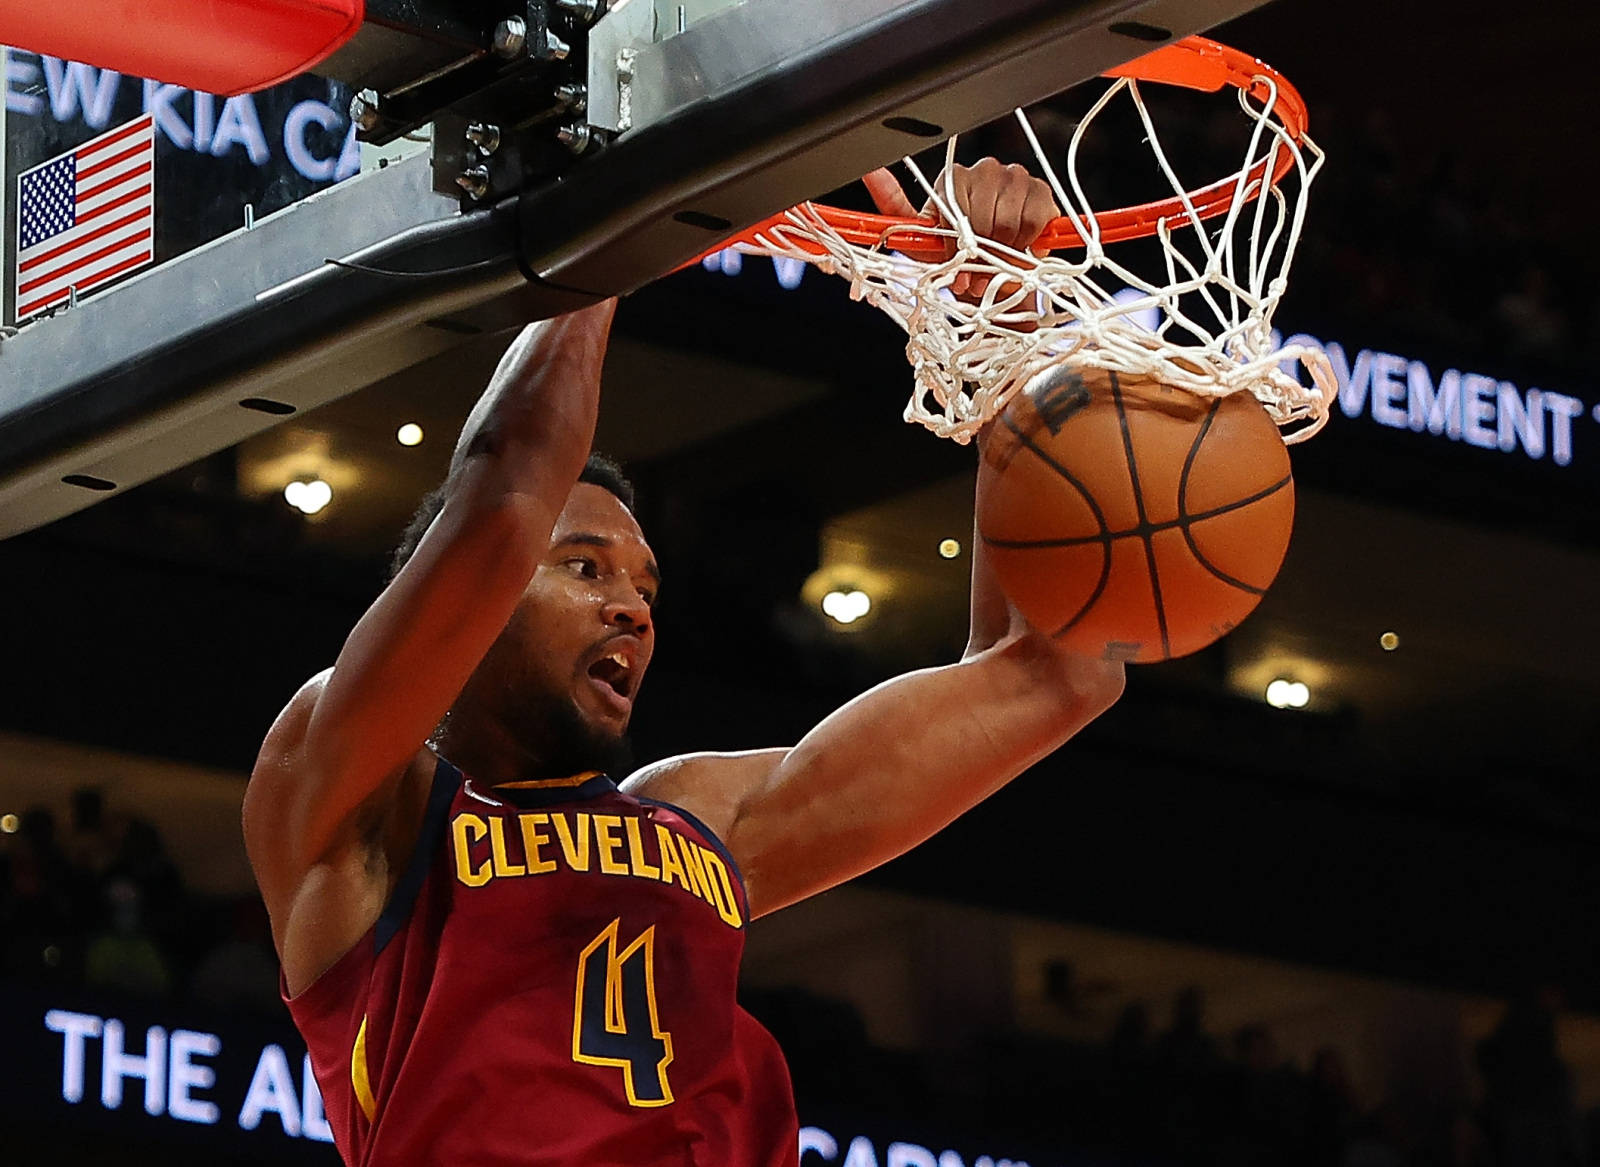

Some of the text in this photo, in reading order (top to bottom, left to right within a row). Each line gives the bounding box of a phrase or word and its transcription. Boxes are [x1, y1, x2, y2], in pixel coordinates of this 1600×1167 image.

[142, 78, 271, 167] KIA
[1222, 327, 1584, 467] VEMENT
[451, 812, 743, 930] CLEVELAND
[43, 1008, 223, 1125] THE
[572, 915, 675, 1108] 4
